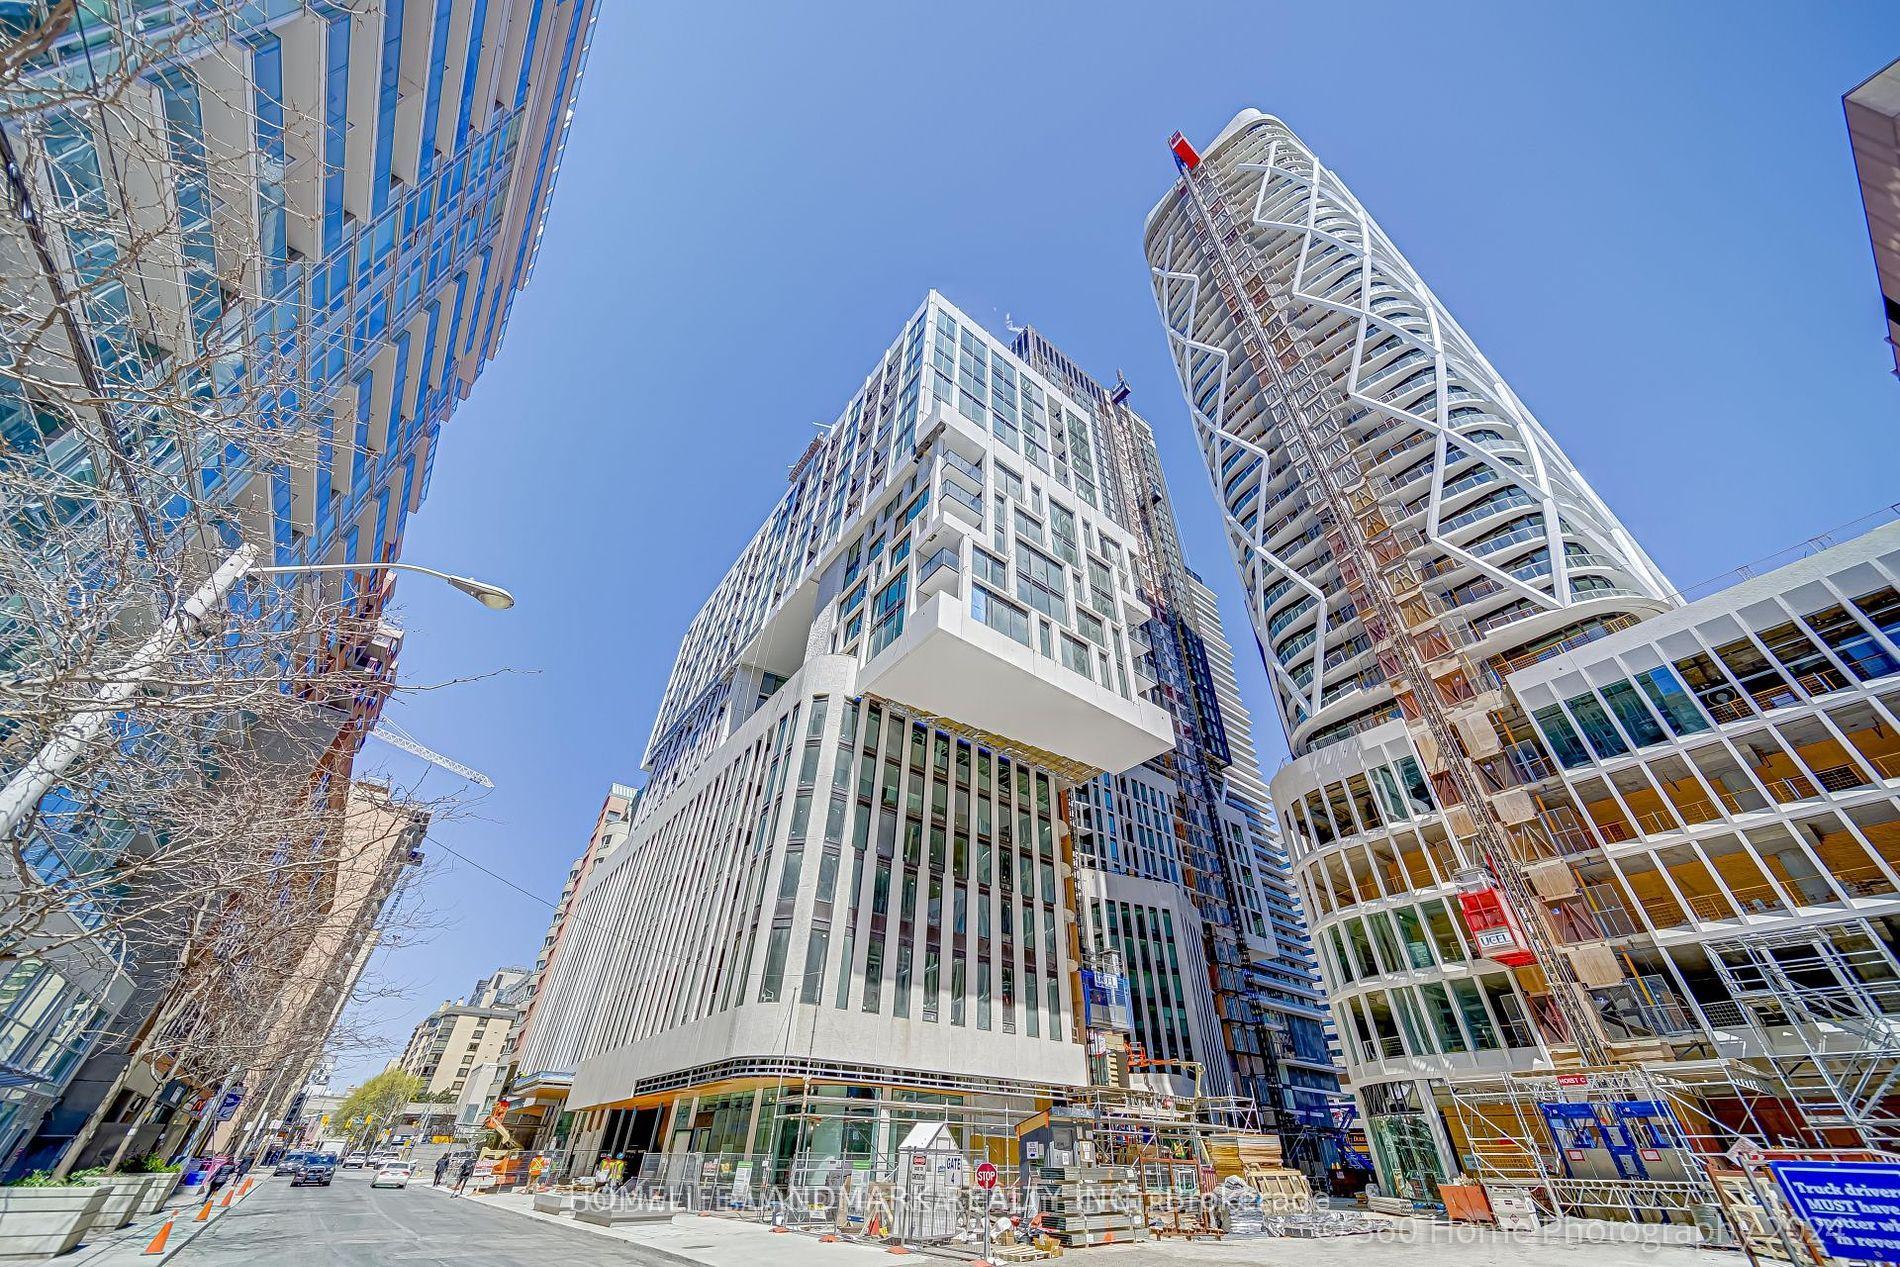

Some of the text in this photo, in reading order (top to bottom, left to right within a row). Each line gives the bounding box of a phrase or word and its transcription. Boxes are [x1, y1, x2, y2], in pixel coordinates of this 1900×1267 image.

[1480, 933, 1510, 946] UCEL
[947, 1158, 961, 1170] GATE
[978, 1171, 995, 1180] STOP
[1792, 1181, 1844, 1196] Truck
[1805, 1198, 1900, 1215] MUST have
[1814, 1217, 1877, 1233] spotter
